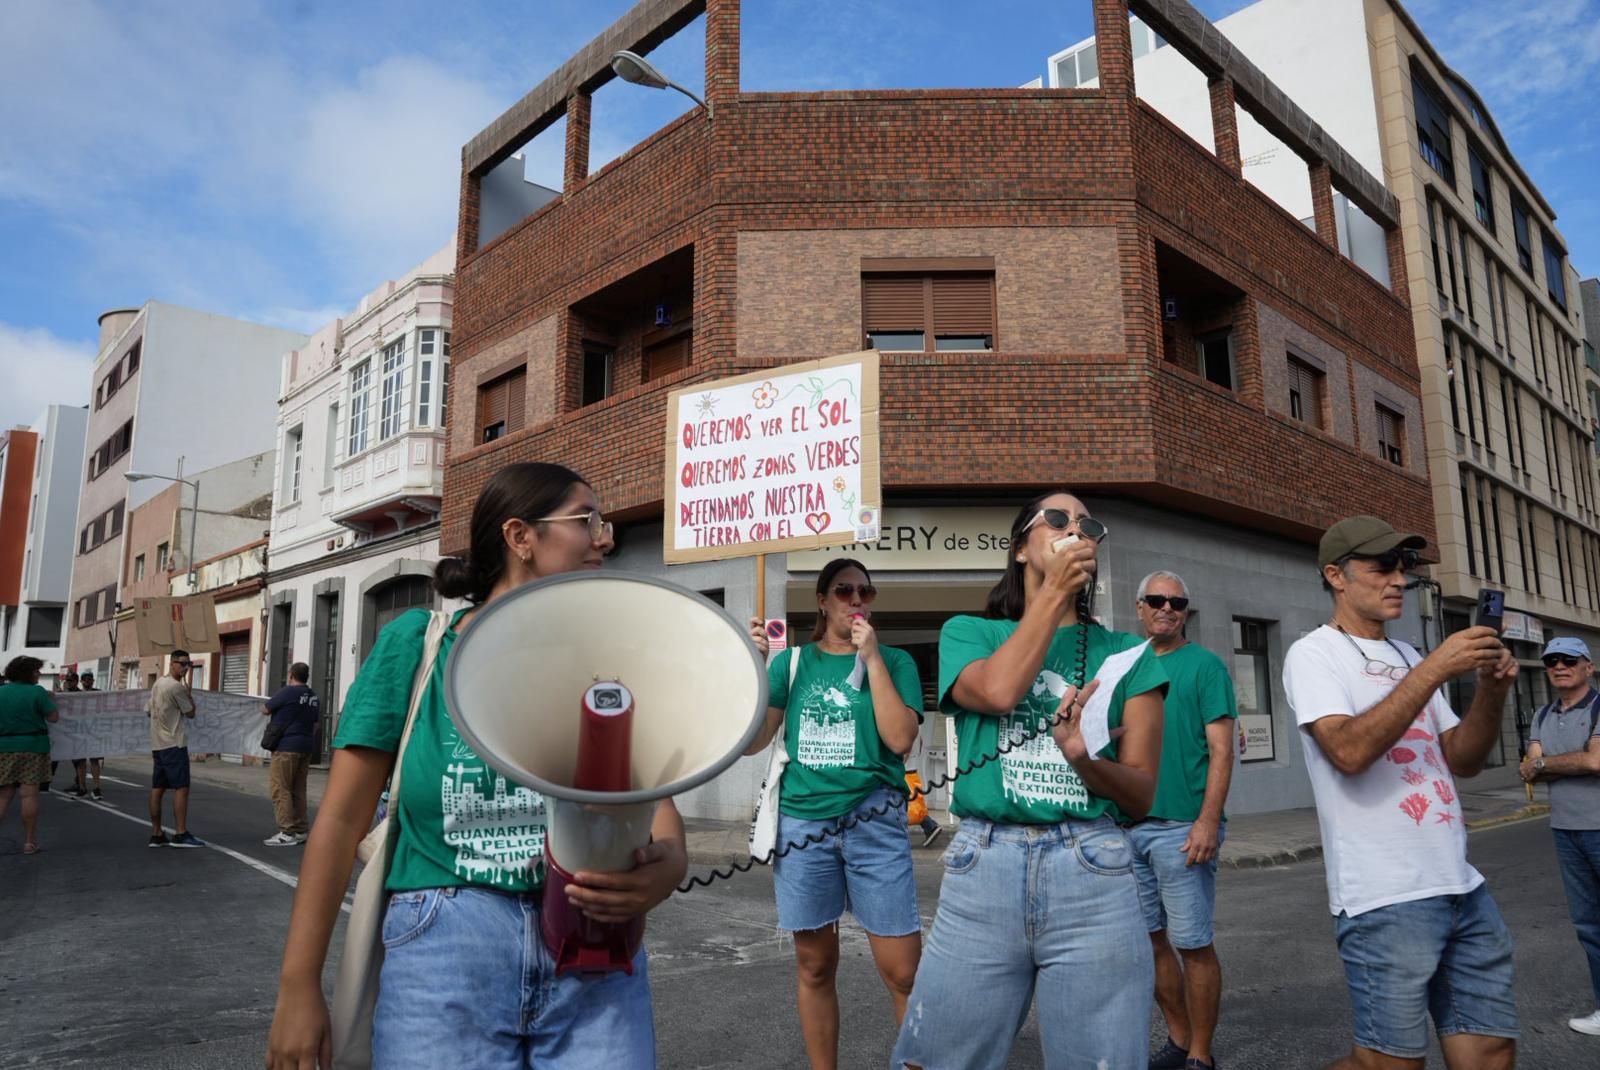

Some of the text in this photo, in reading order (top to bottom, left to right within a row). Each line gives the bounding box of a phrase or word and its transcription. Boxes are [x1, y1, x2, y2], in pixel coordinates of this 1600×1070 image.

[683, 398, 851, 450] QUEREMOS VER EL SOL
[681, 435, 860, 488] QUEREMOS ZONAS VERDES
[681, 482, 826, 527] DEFENDAMOS NUESTRA
[750, 521, 771, 542] CON
[777, 519, 794, 539] EL
[944, 533, 969, 550] de
[1002, 765, 1083, 786] EN PELIGRO
[462, 842, 474, 851] N
